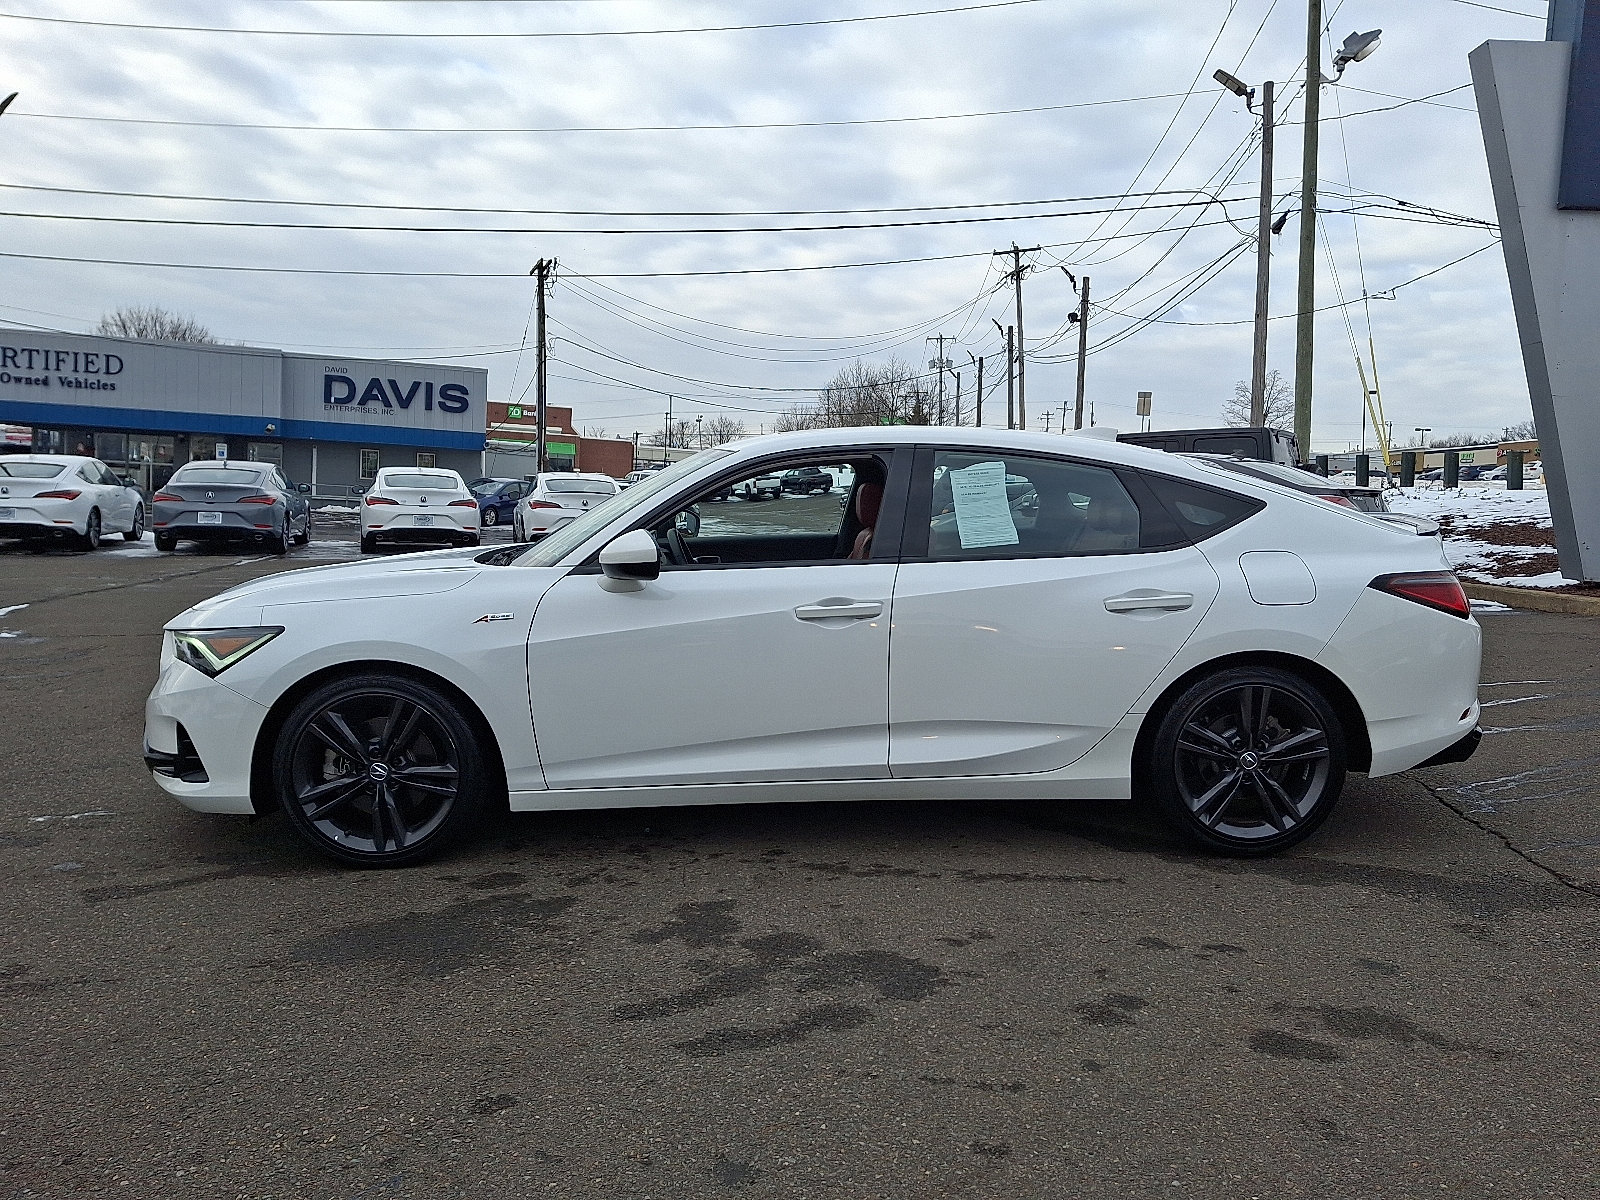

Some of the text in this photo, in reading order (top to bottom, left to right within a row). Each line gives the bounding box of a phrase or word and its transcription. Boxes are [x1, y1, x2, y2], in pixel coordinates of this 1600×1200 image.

[0, 346, 124, 375] RTIFIED
[324, 366, 348, 374] DAVID
[0, 371, 116, 391] Owned Vehicles
[323, 374, 470, 414] DAVIS
